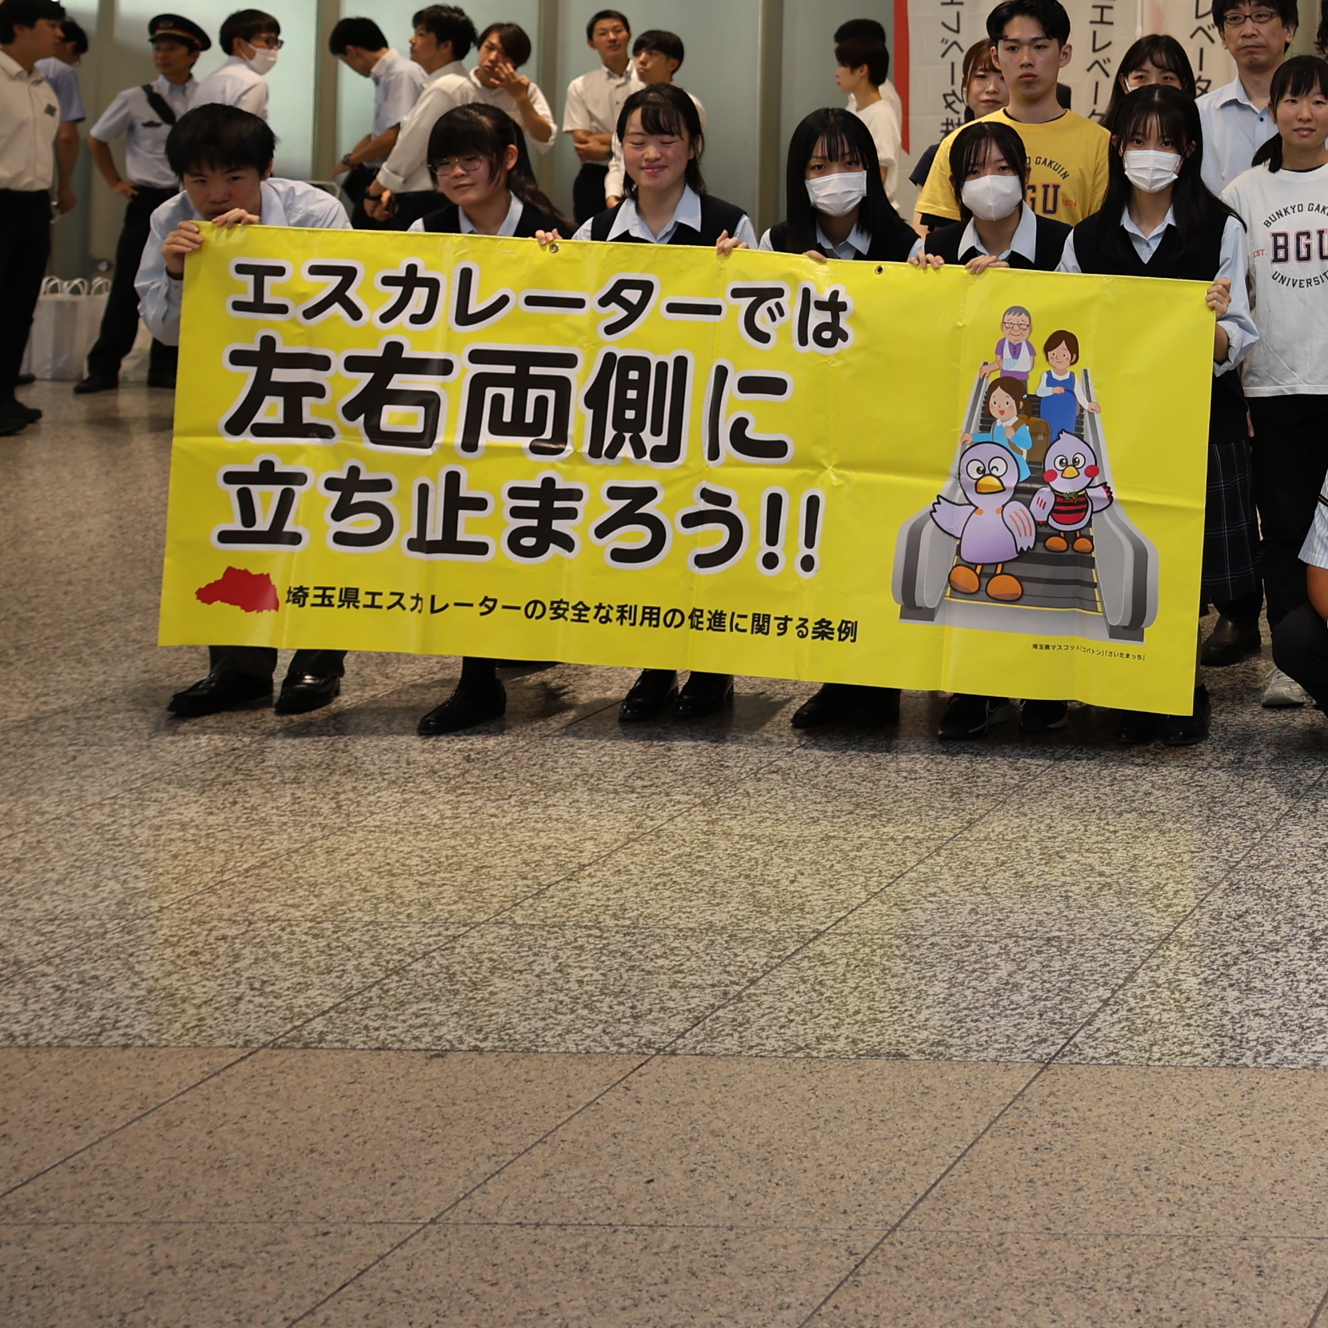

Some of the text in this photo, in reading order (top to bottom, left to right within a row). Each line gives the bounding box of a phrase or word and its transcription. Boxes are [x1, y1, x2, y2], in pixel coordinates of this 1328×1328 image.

[1035, 156, 1070, 180] GAKUIN
[1263, 203, 1304, 228] BUNKYO
[231, 262, 850, 350] エスカレーターでは
[224, 332, 792, 465] 左右両側に
[216, 458, 823, 575] 立ち止まろう!!
[285, 584, 859, 643] 埼玉県エスカレーターの安全な利用の促進に関する条例
